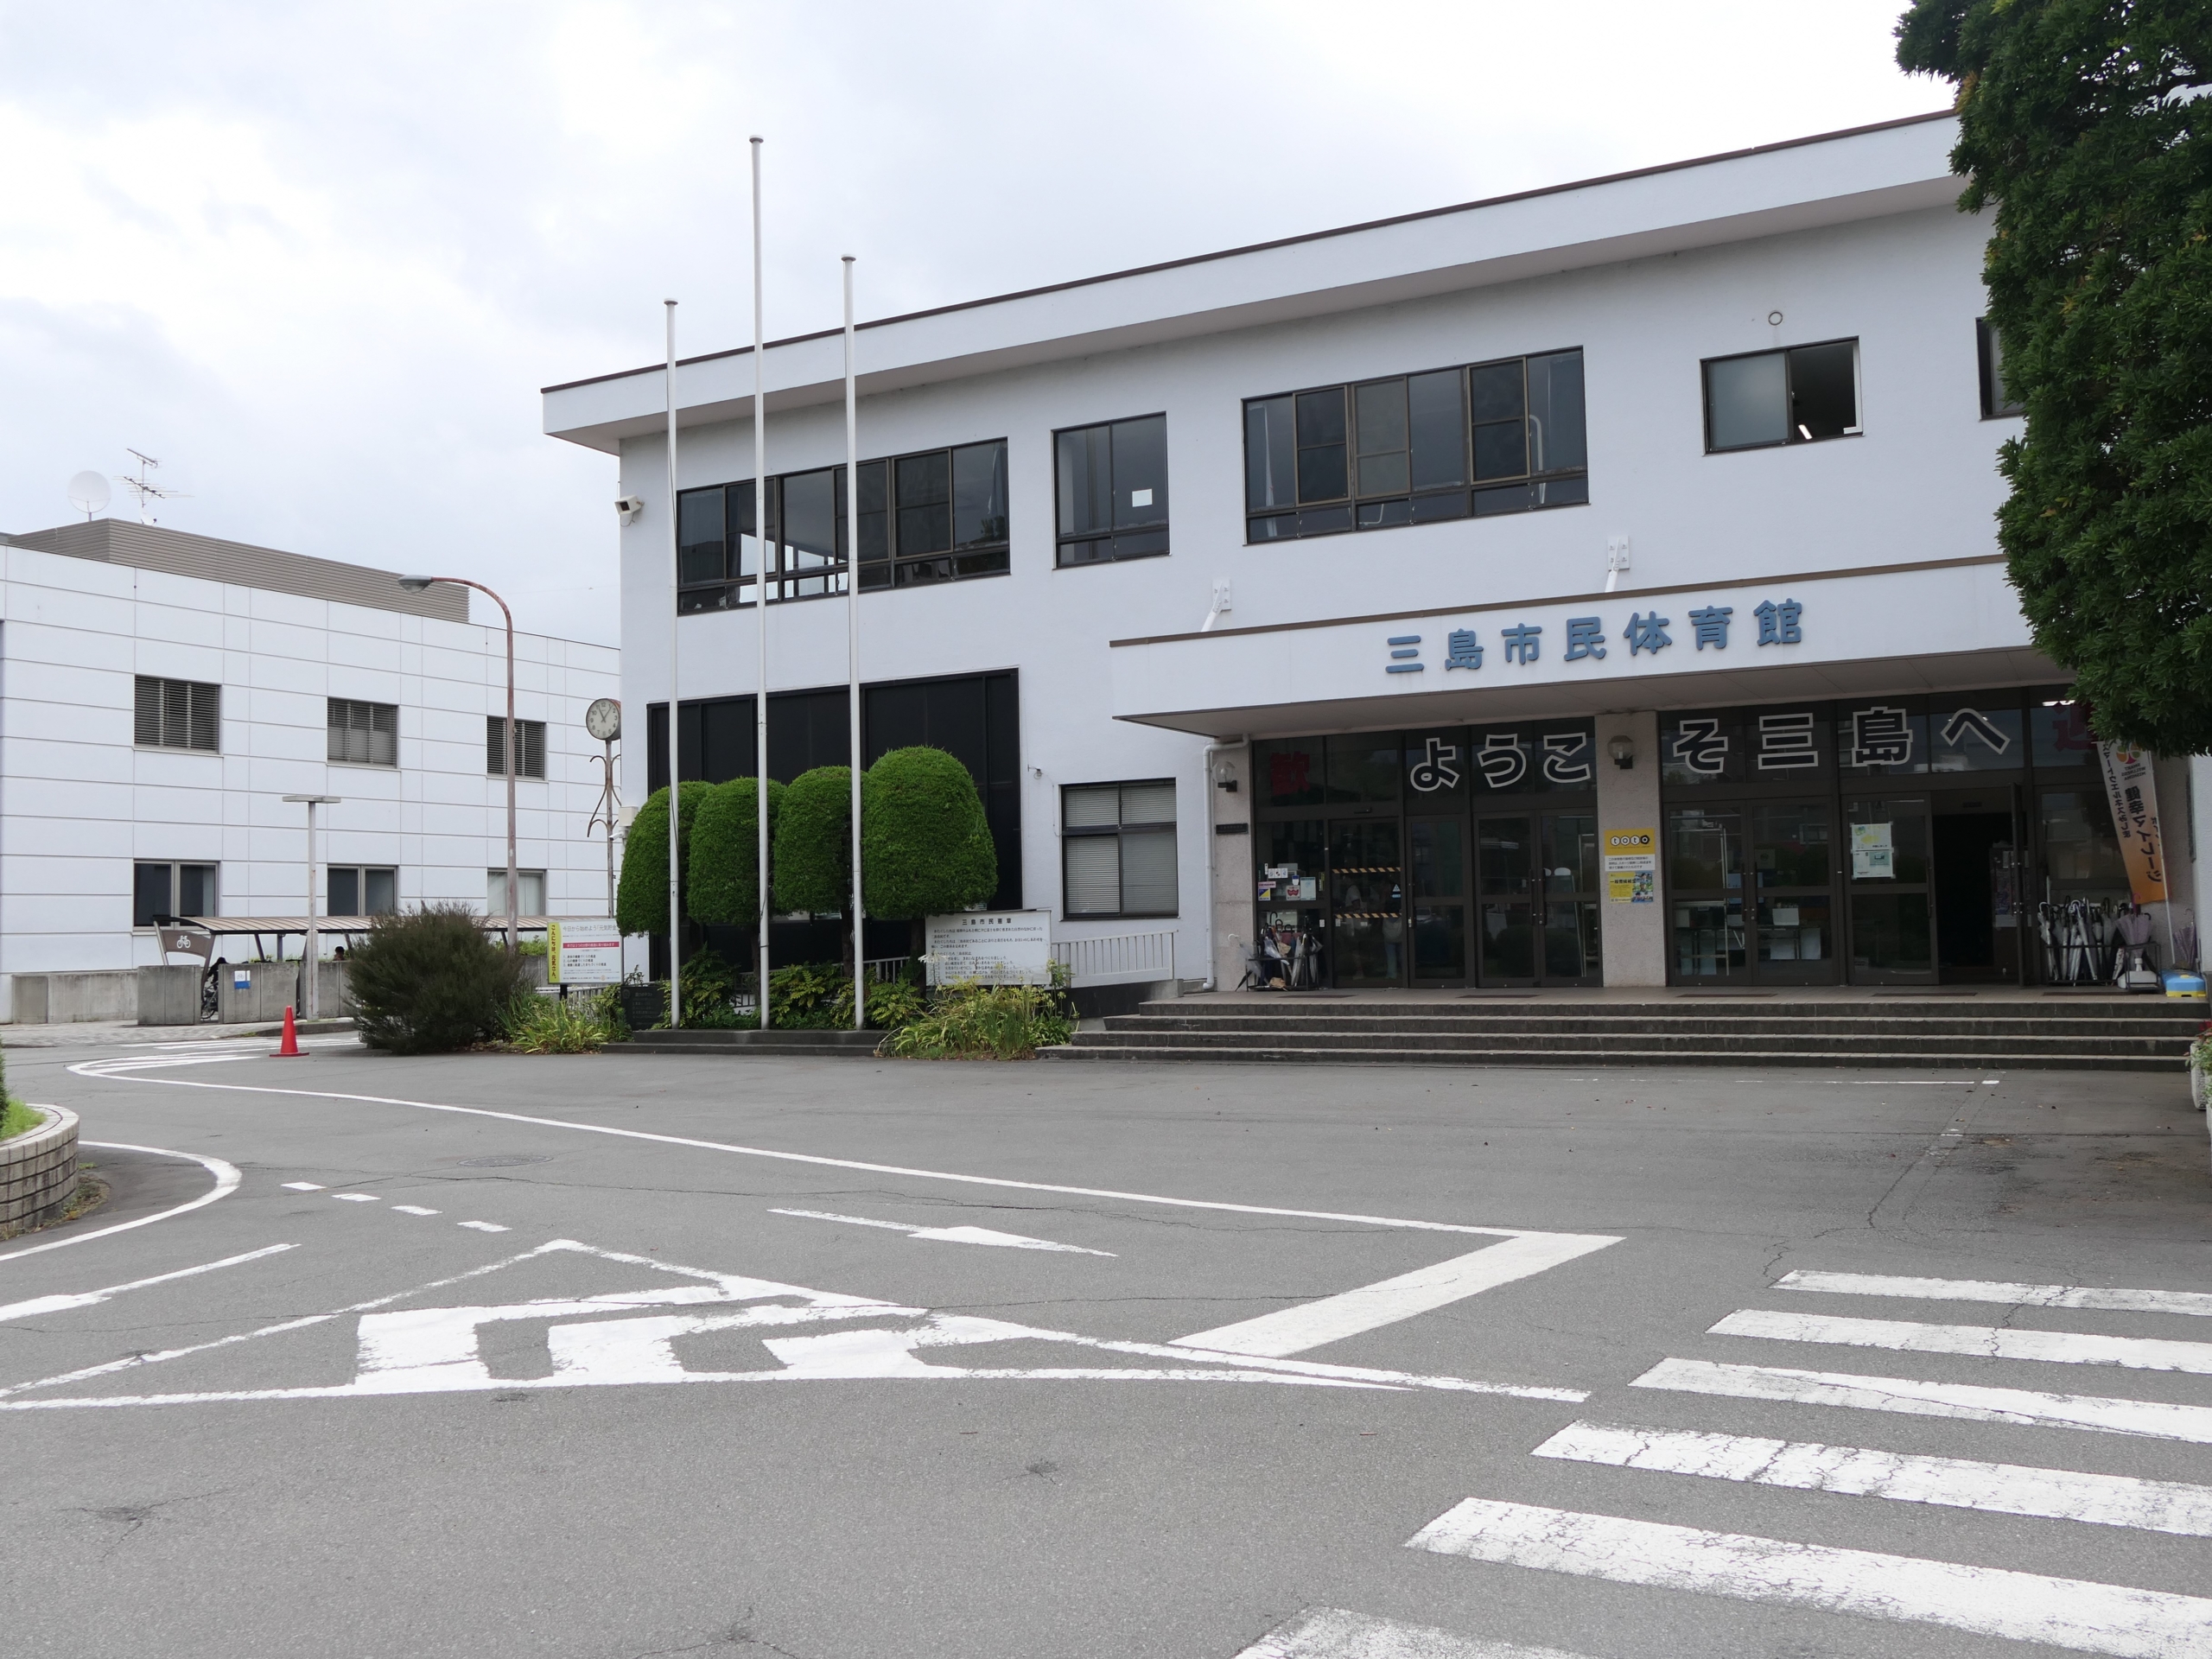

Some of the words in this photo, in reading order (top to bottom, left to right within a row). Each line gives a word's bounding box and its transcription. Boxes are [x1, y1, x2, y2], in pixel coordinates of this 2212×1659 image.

[1385, 598, 1802, 673] 三島市民体育館
[1611, 835, 1650, 846] toto
